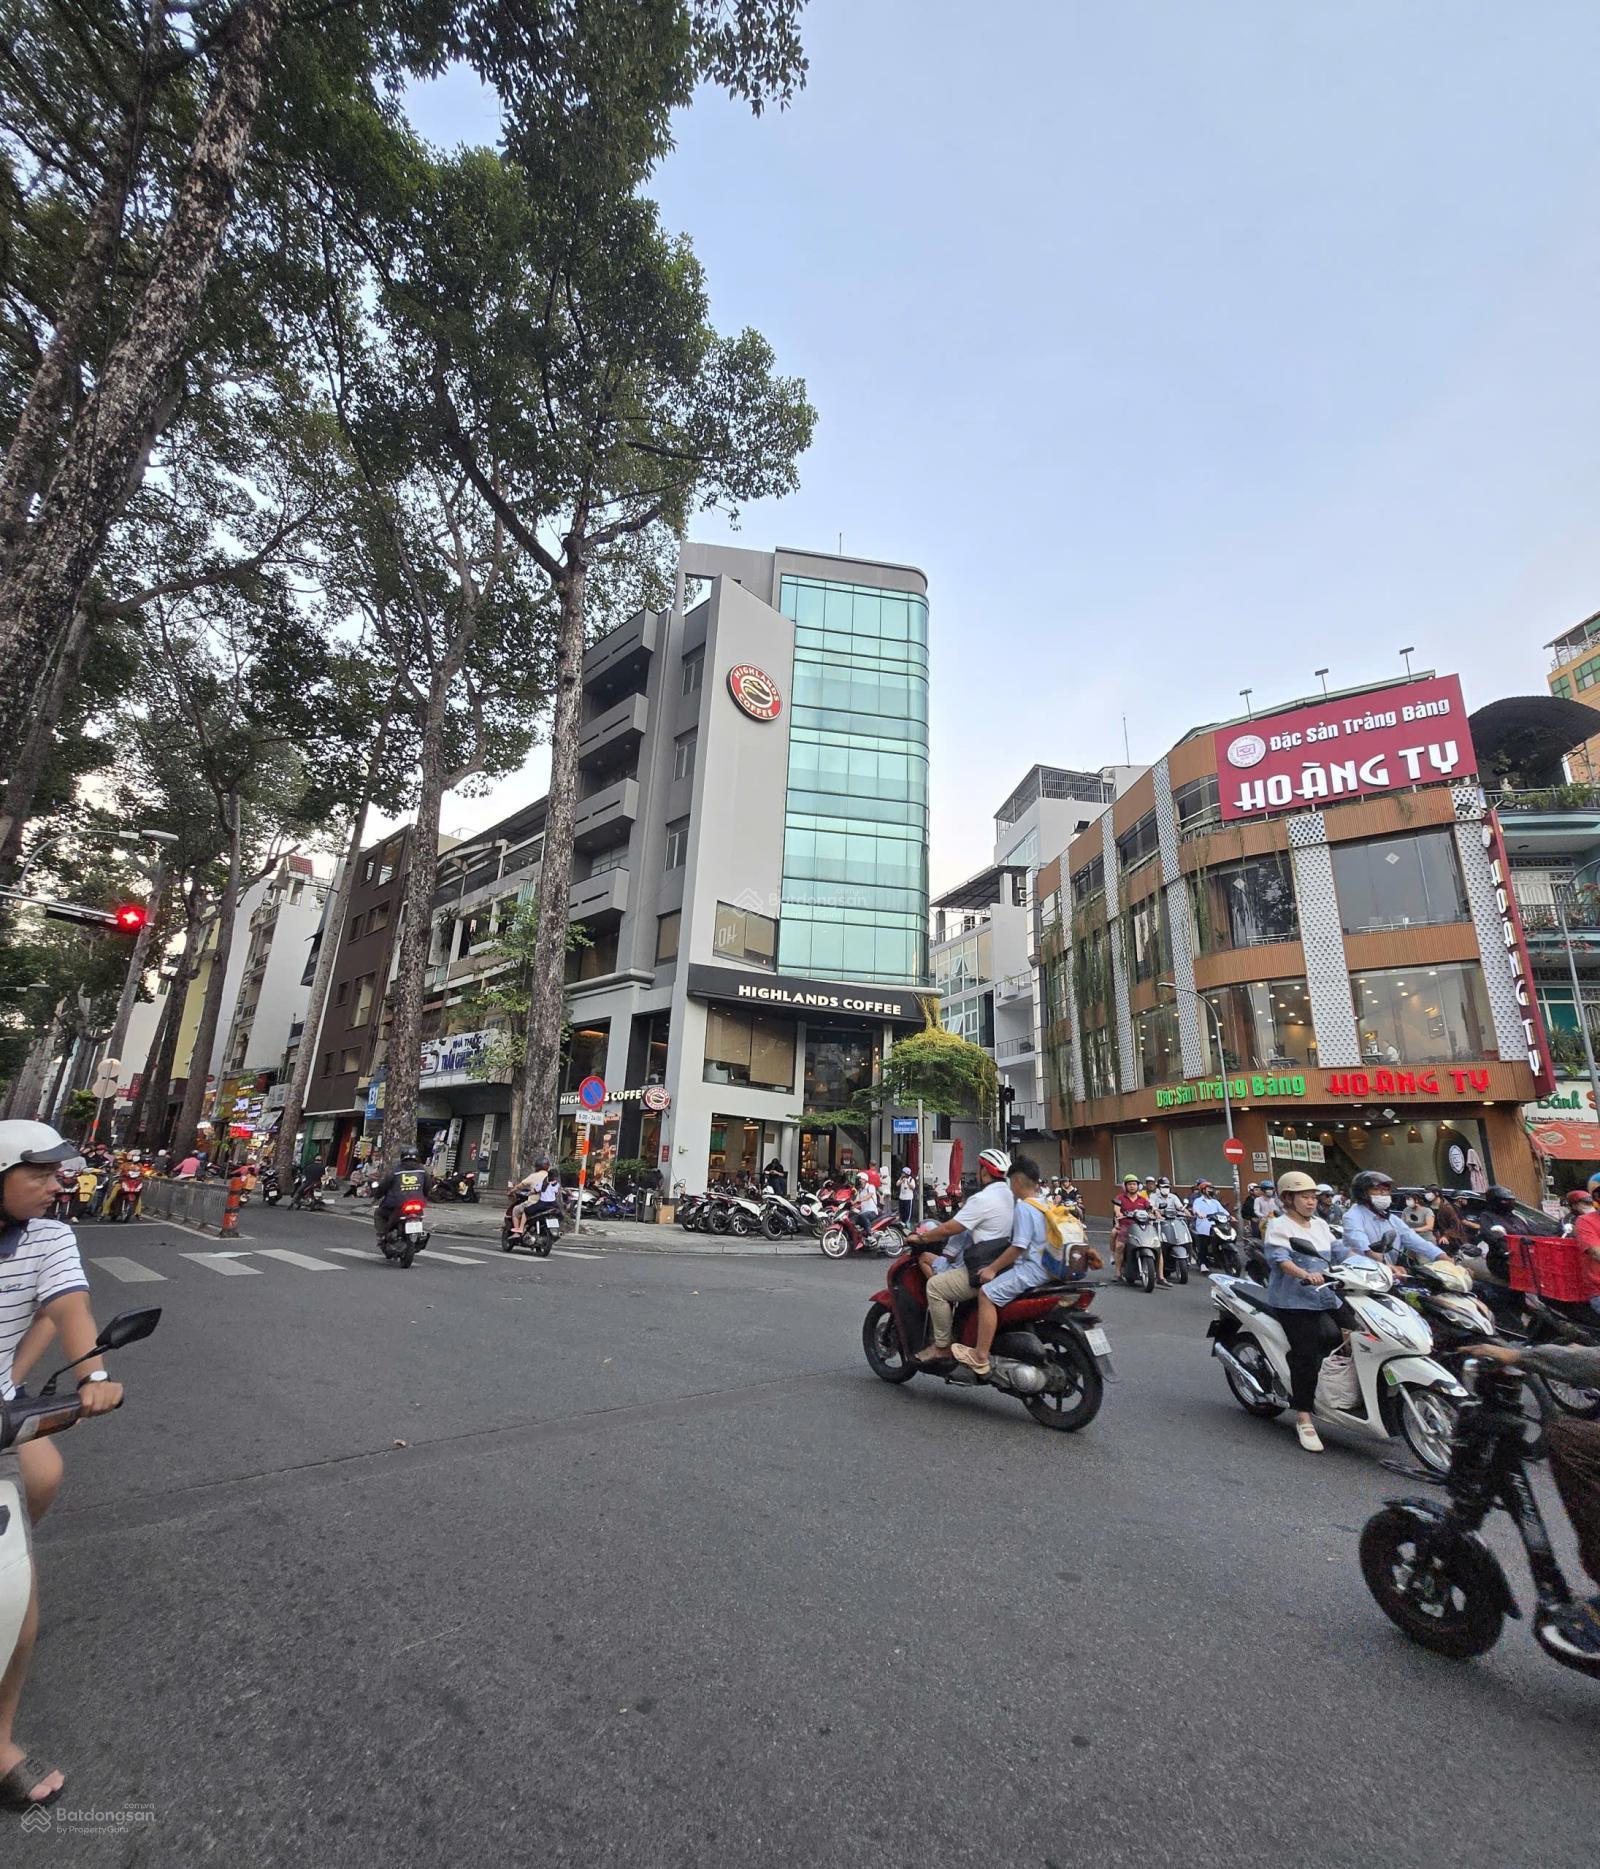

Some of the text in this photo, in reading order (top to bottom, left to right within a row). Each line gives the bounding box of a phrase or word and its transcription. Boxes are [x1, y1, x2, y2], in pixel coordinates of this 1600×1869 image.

[734, 666, 779, 702] HIGHLANDS
[738, 693, 774, 717] COFFEE
[1270, 698, 1450, 751] Đặc Sản Trảng Bàng
[1233, 740, 1459, 812] HOÀNG TY
[738, 984, 902, 1016] HIGHLANDS COFFEE
[1251, 1072, 1306, 1097] Bàng
[1326, 1066, 1490, 1096] HOÀNG TY
[401, 1173, 418, 1185] be
